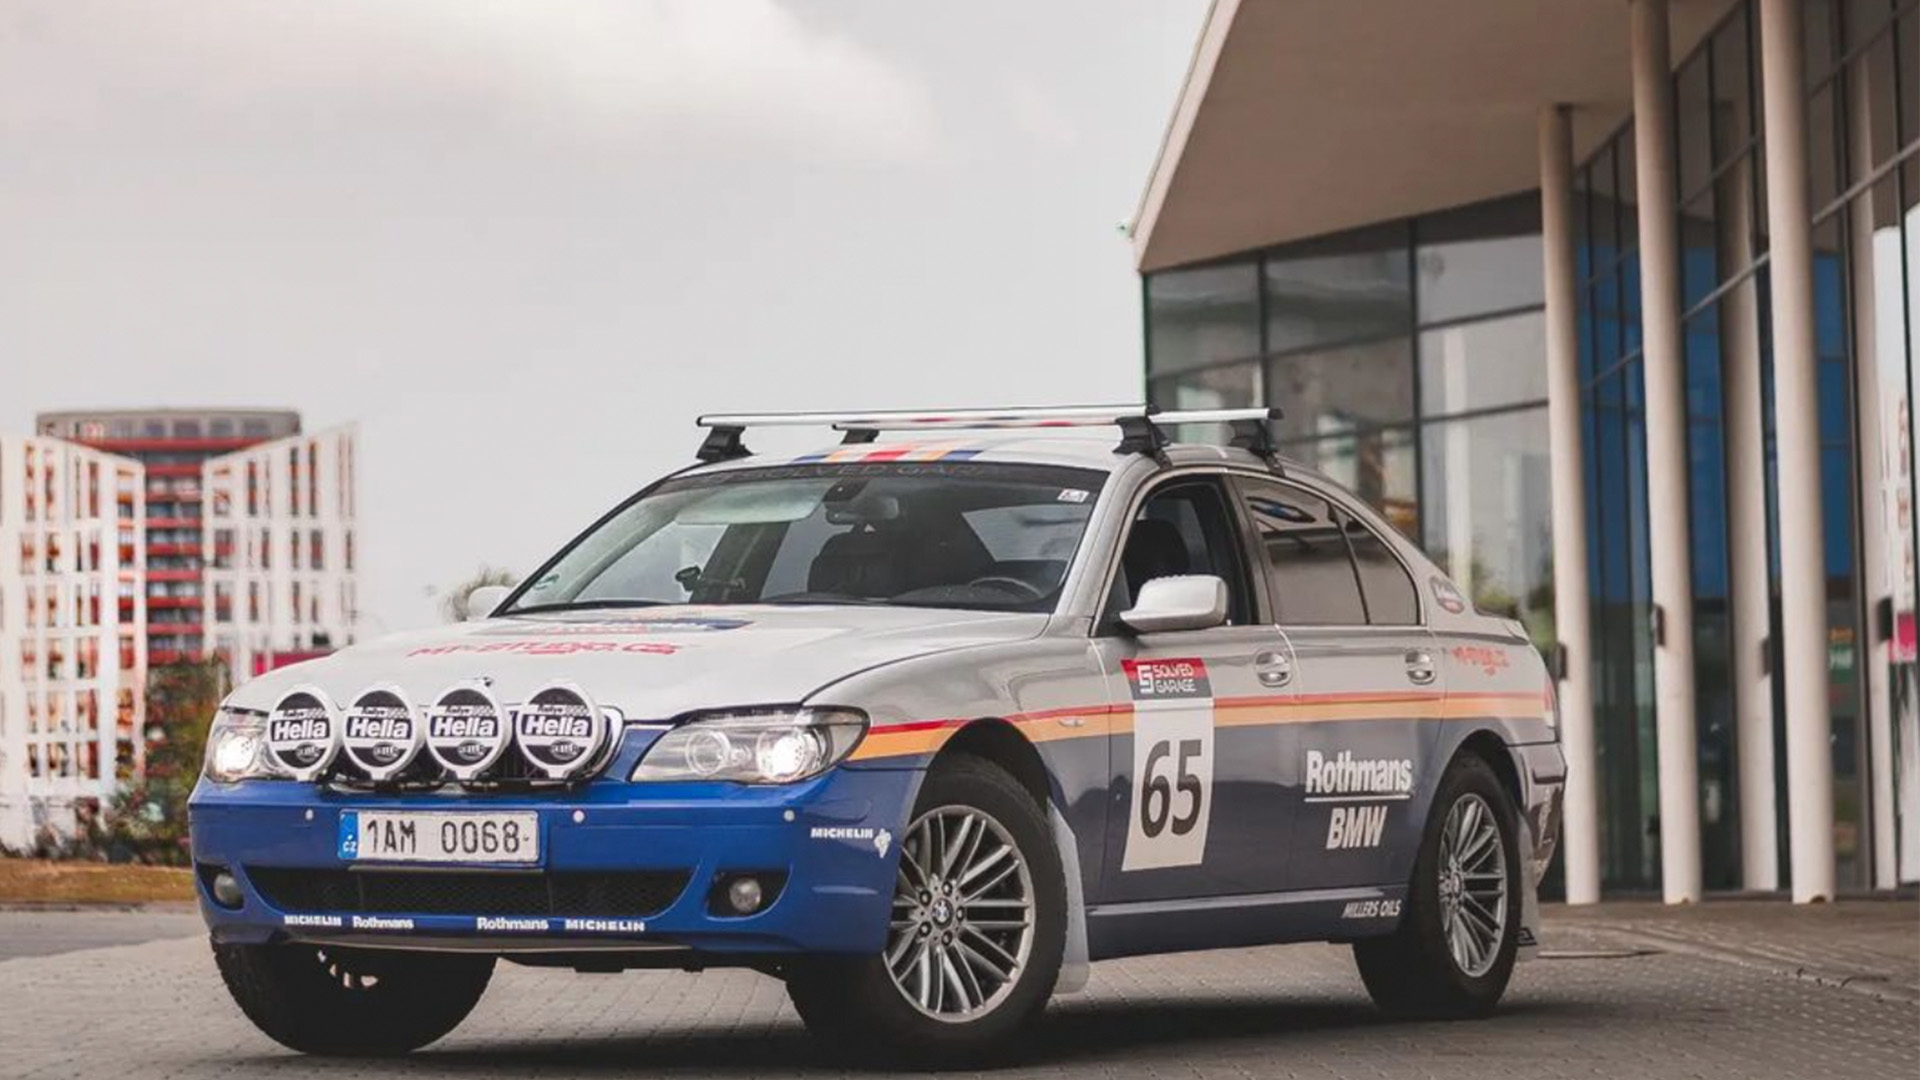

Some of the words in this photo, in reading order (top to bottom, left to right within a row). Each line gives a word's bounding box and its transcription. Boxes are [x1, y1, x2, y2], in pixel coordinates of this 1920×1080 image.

[1155, 679, 1198, 693] GARAGE
[273, 720, 327, 741] Hella
[350, 716, 409, 738] Hella
[433, 716, 495, 737] Hella
[525, 714, 589, 737] Hella
[1304, 749, 1413, 794] Rothmans
[1141, 739, 1202, 838] 65
[367, 819, 416, 853] 1AM
[440, 820, 520, 854] 0068
[810, 827, 874, 839] MICHELIN
[1326, 805, 1388, 850] BMW
[284, 914, 342, 926] MICHELIN
[352, 915, 414, 929] Rothmans
[476, 916, 549, 930] Rothmans
[565, 919, 645, 932] MICHELIN
